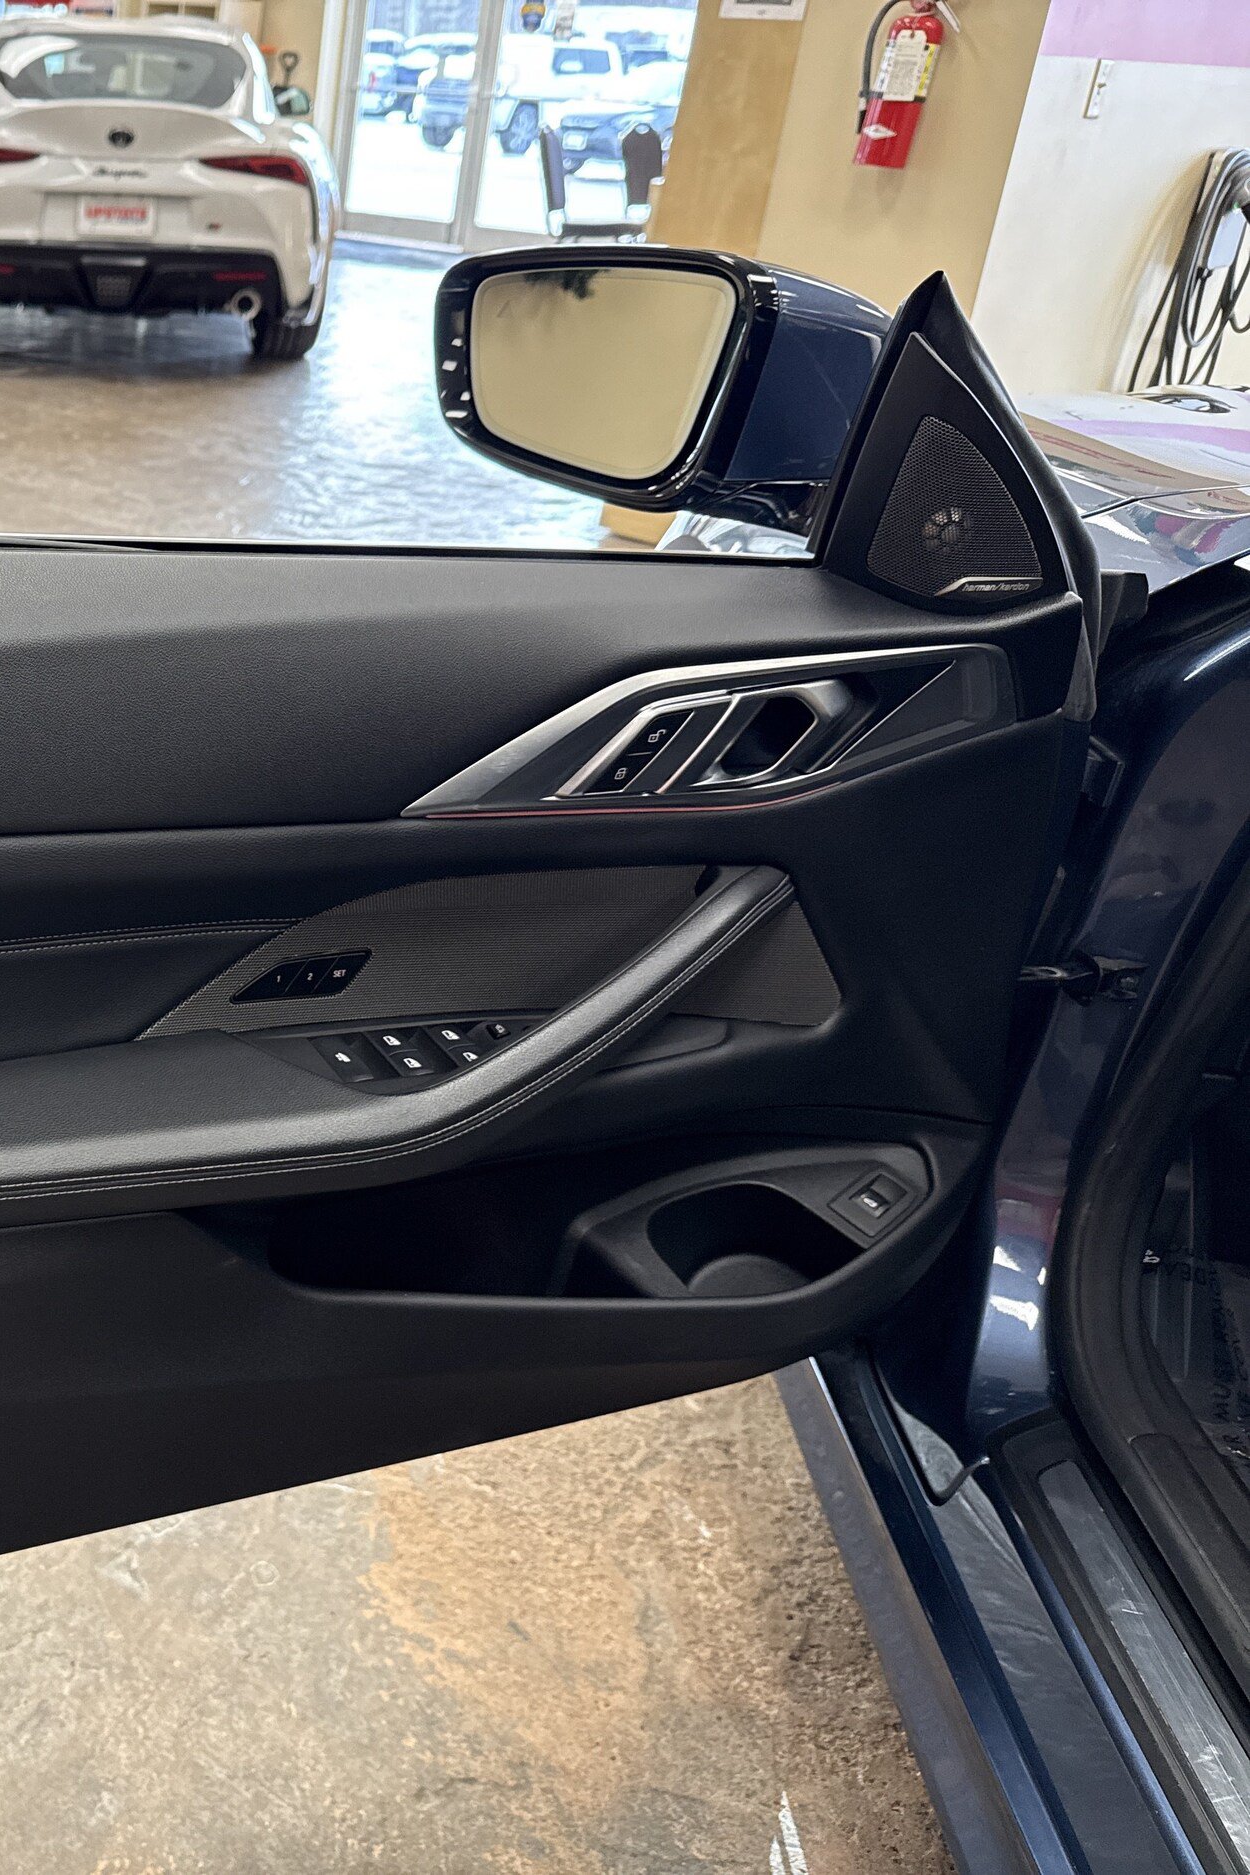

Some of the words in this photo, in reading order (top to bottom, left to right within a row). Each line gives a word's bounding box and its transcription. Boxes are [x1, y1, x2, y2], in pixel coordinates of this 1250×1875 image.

[962, 582, 1030, 592] harman/kardon
[307, 973, 313, 981] 2
[333, 969, 347, 978] SET
